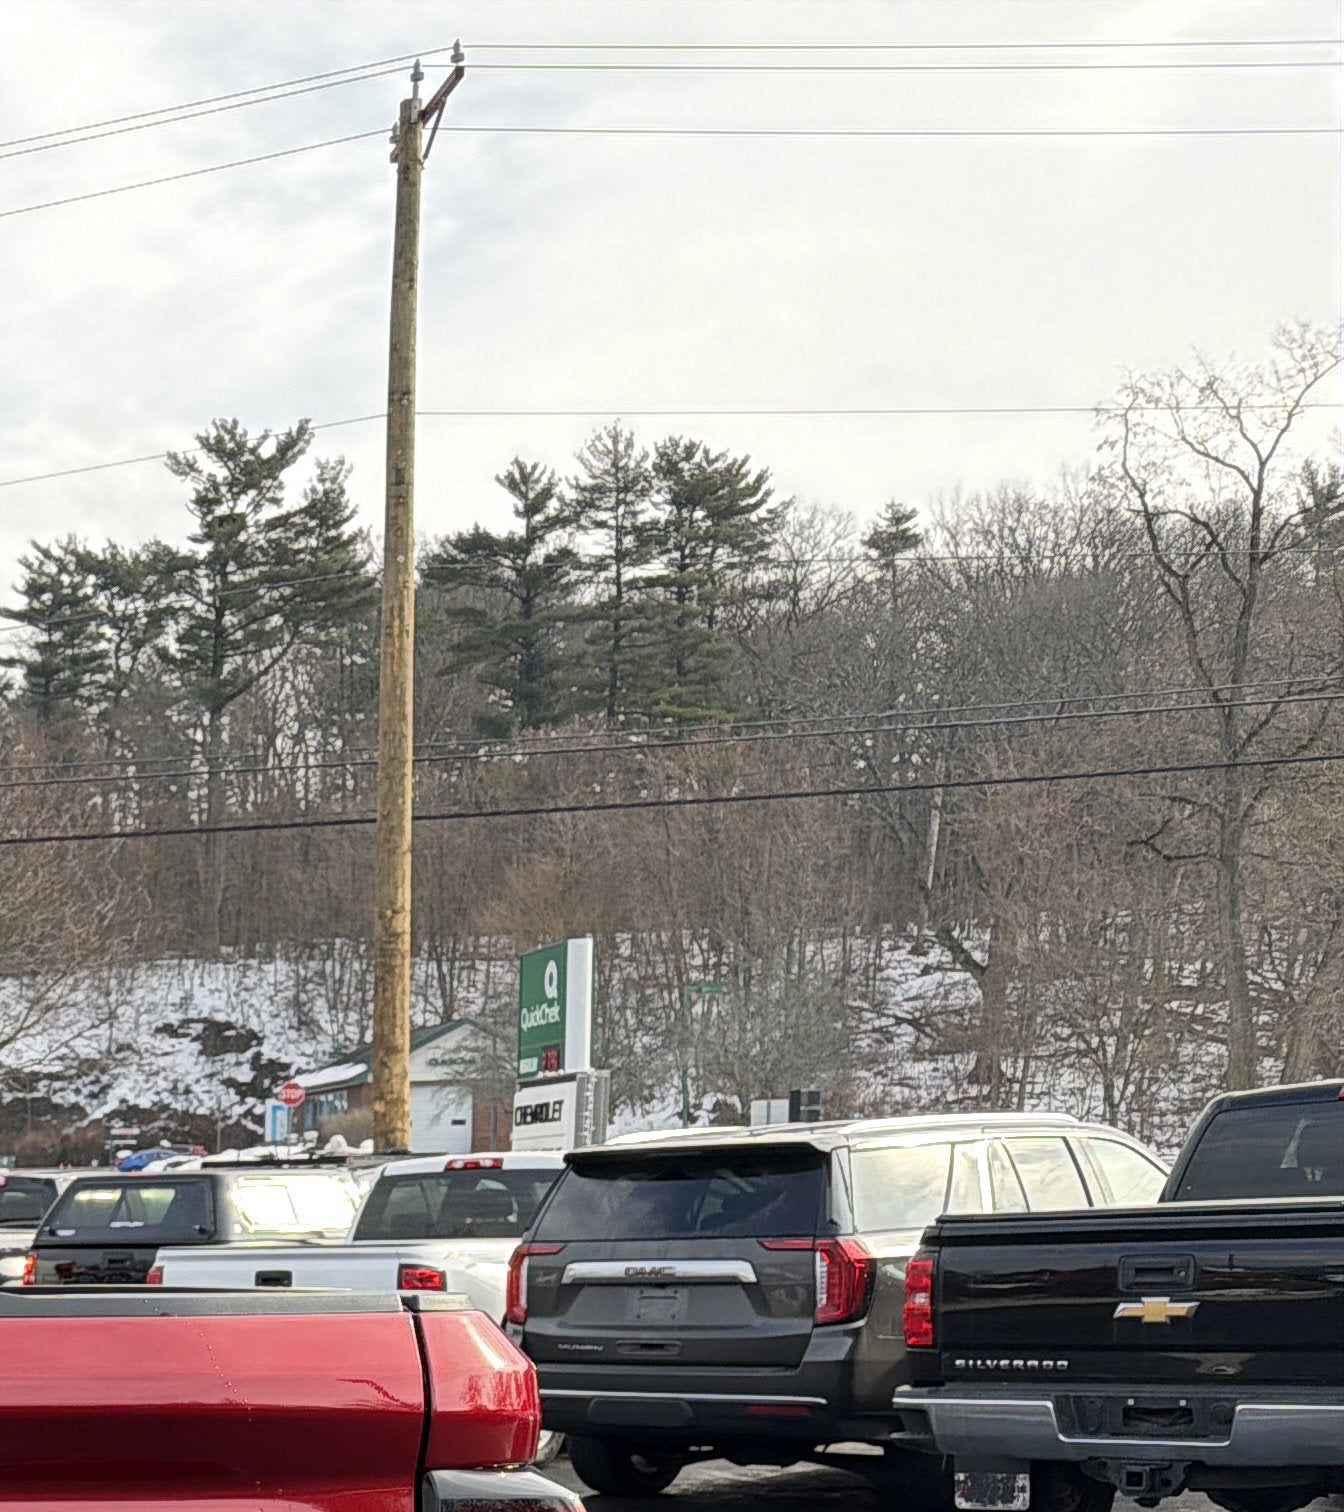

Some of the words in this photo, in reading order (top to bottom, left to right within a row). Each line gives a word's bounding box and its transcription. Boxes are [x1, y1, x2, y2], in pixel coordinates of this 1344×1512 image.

[520, 1000, 561, 1033] QuickChek
[514, 1099, 565, 1127] CHEVROLET
[624, 1266, 676, 1279] GMC
[955, 1359, 1069, 1370] SILVERADO
